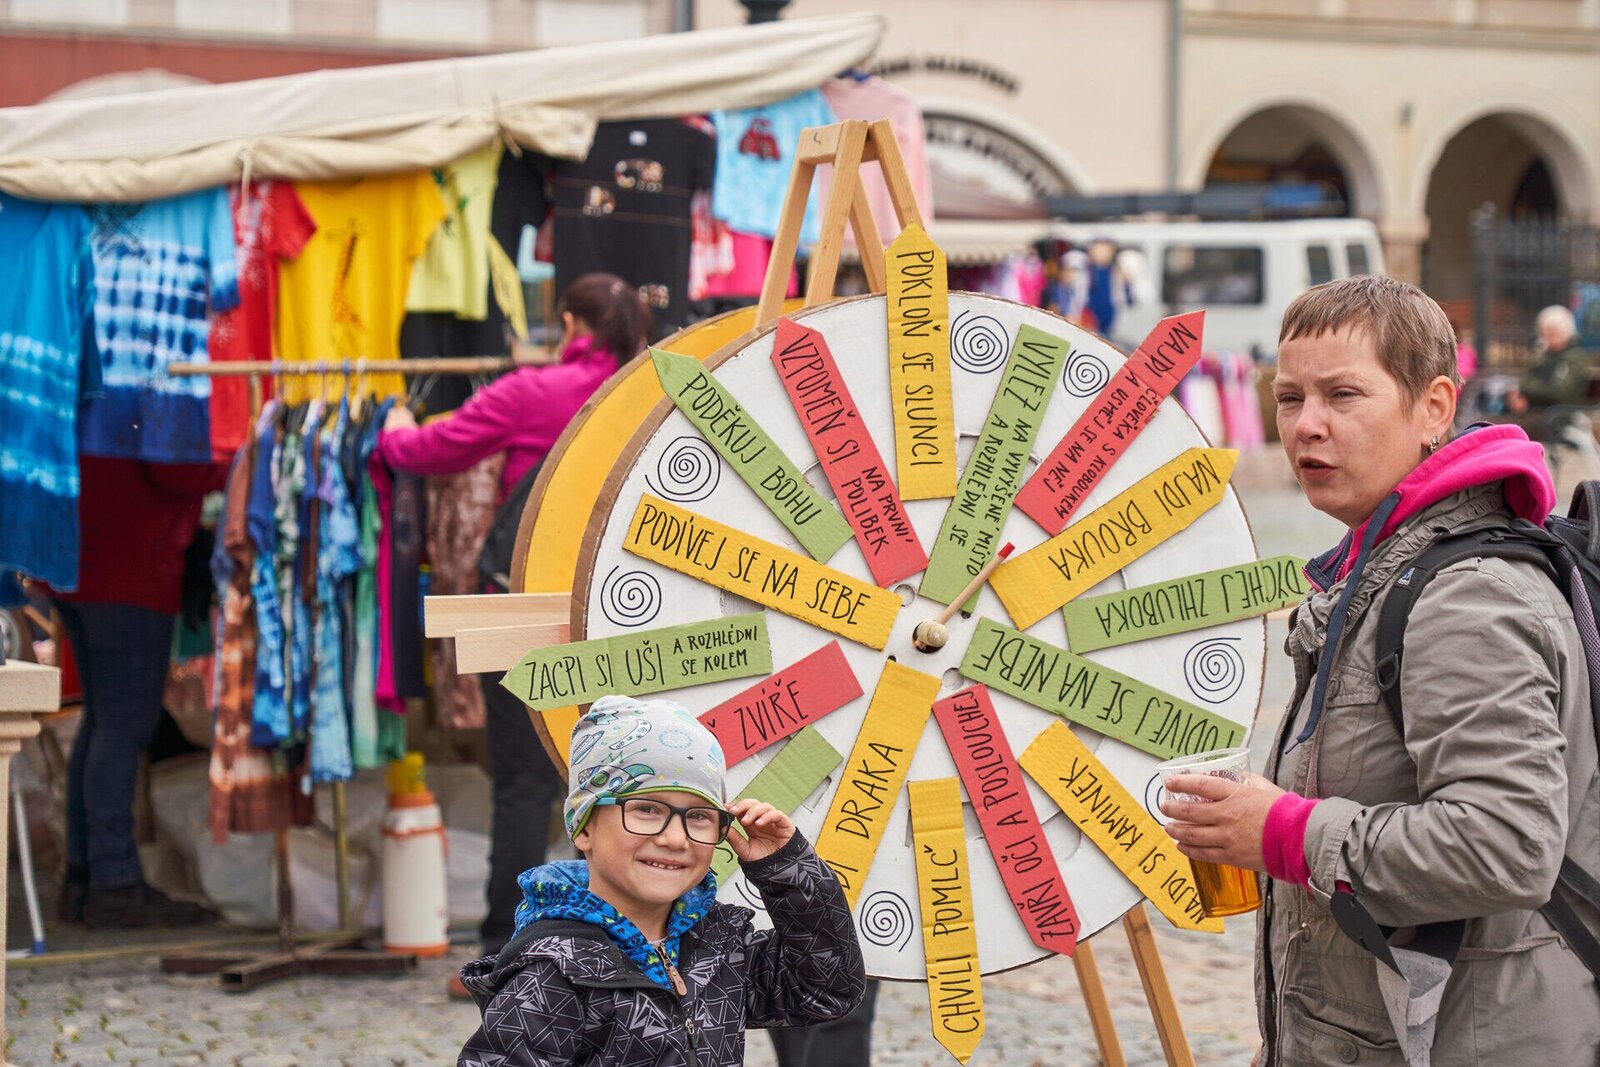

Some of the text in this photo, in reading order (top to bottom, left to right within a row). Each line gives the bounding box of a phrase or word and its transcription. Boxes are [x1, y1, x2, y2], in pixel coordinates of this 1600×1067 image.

[895, 249, 944, 467] POKLOŇ SE SLUNCI
[1003, 342, 1058, 412] VYLEZ
[1145, 322, 1198, 377] NAJDI
[778, 331, 861, 464] VZPOMEŇ SI
[1012, 418, 1032, 442] NA
[1043, 371, 1140, 492] A USMĚJ SE NA NĚJ
[678, 371, 823, 526] PODĚKUJ BOHU
[950, 414, 1009, 547] A ROZHLÉDNI SE
[1054, 388, 1159, 519] ČLOVĚKA S KLOBOUKEM
[841, 477, 890, 556] POLIBEK
[861, 466, 914, 543] NA PRVNÍ
[1049, 453, 1221, 581] NAJDI BROUKA
[634, 503, 872, 626] PODÍVEJ SE NA SEBE
[1095, 560, 1304, 639] DÝCHEJ ZHLUBOKA
[524, 639, 665, 701] ZACPI SI UŠI
[672, 623, 758, 655] A ROZHLÉDNI
[681, 648, 748, 677] SE KOLEM
[973, 629, 1059, 692] NEBE
[732, 678, 809, 751] ZVÍŘE
[1058, 663, 1099, 709] NA
[1096, 680, 1135, 724] SE
[835, 742, 904, 840] DRAKA
[952, 690, 1076, 942] ZAVŘI OČI A POSLOUCHEJ
[1058, 756, 1144, 853] KAMÍNEK
[1138, 846, 1166, 874] SI
[924, 844, 980, 1034] CHVÍLI POMLČ
